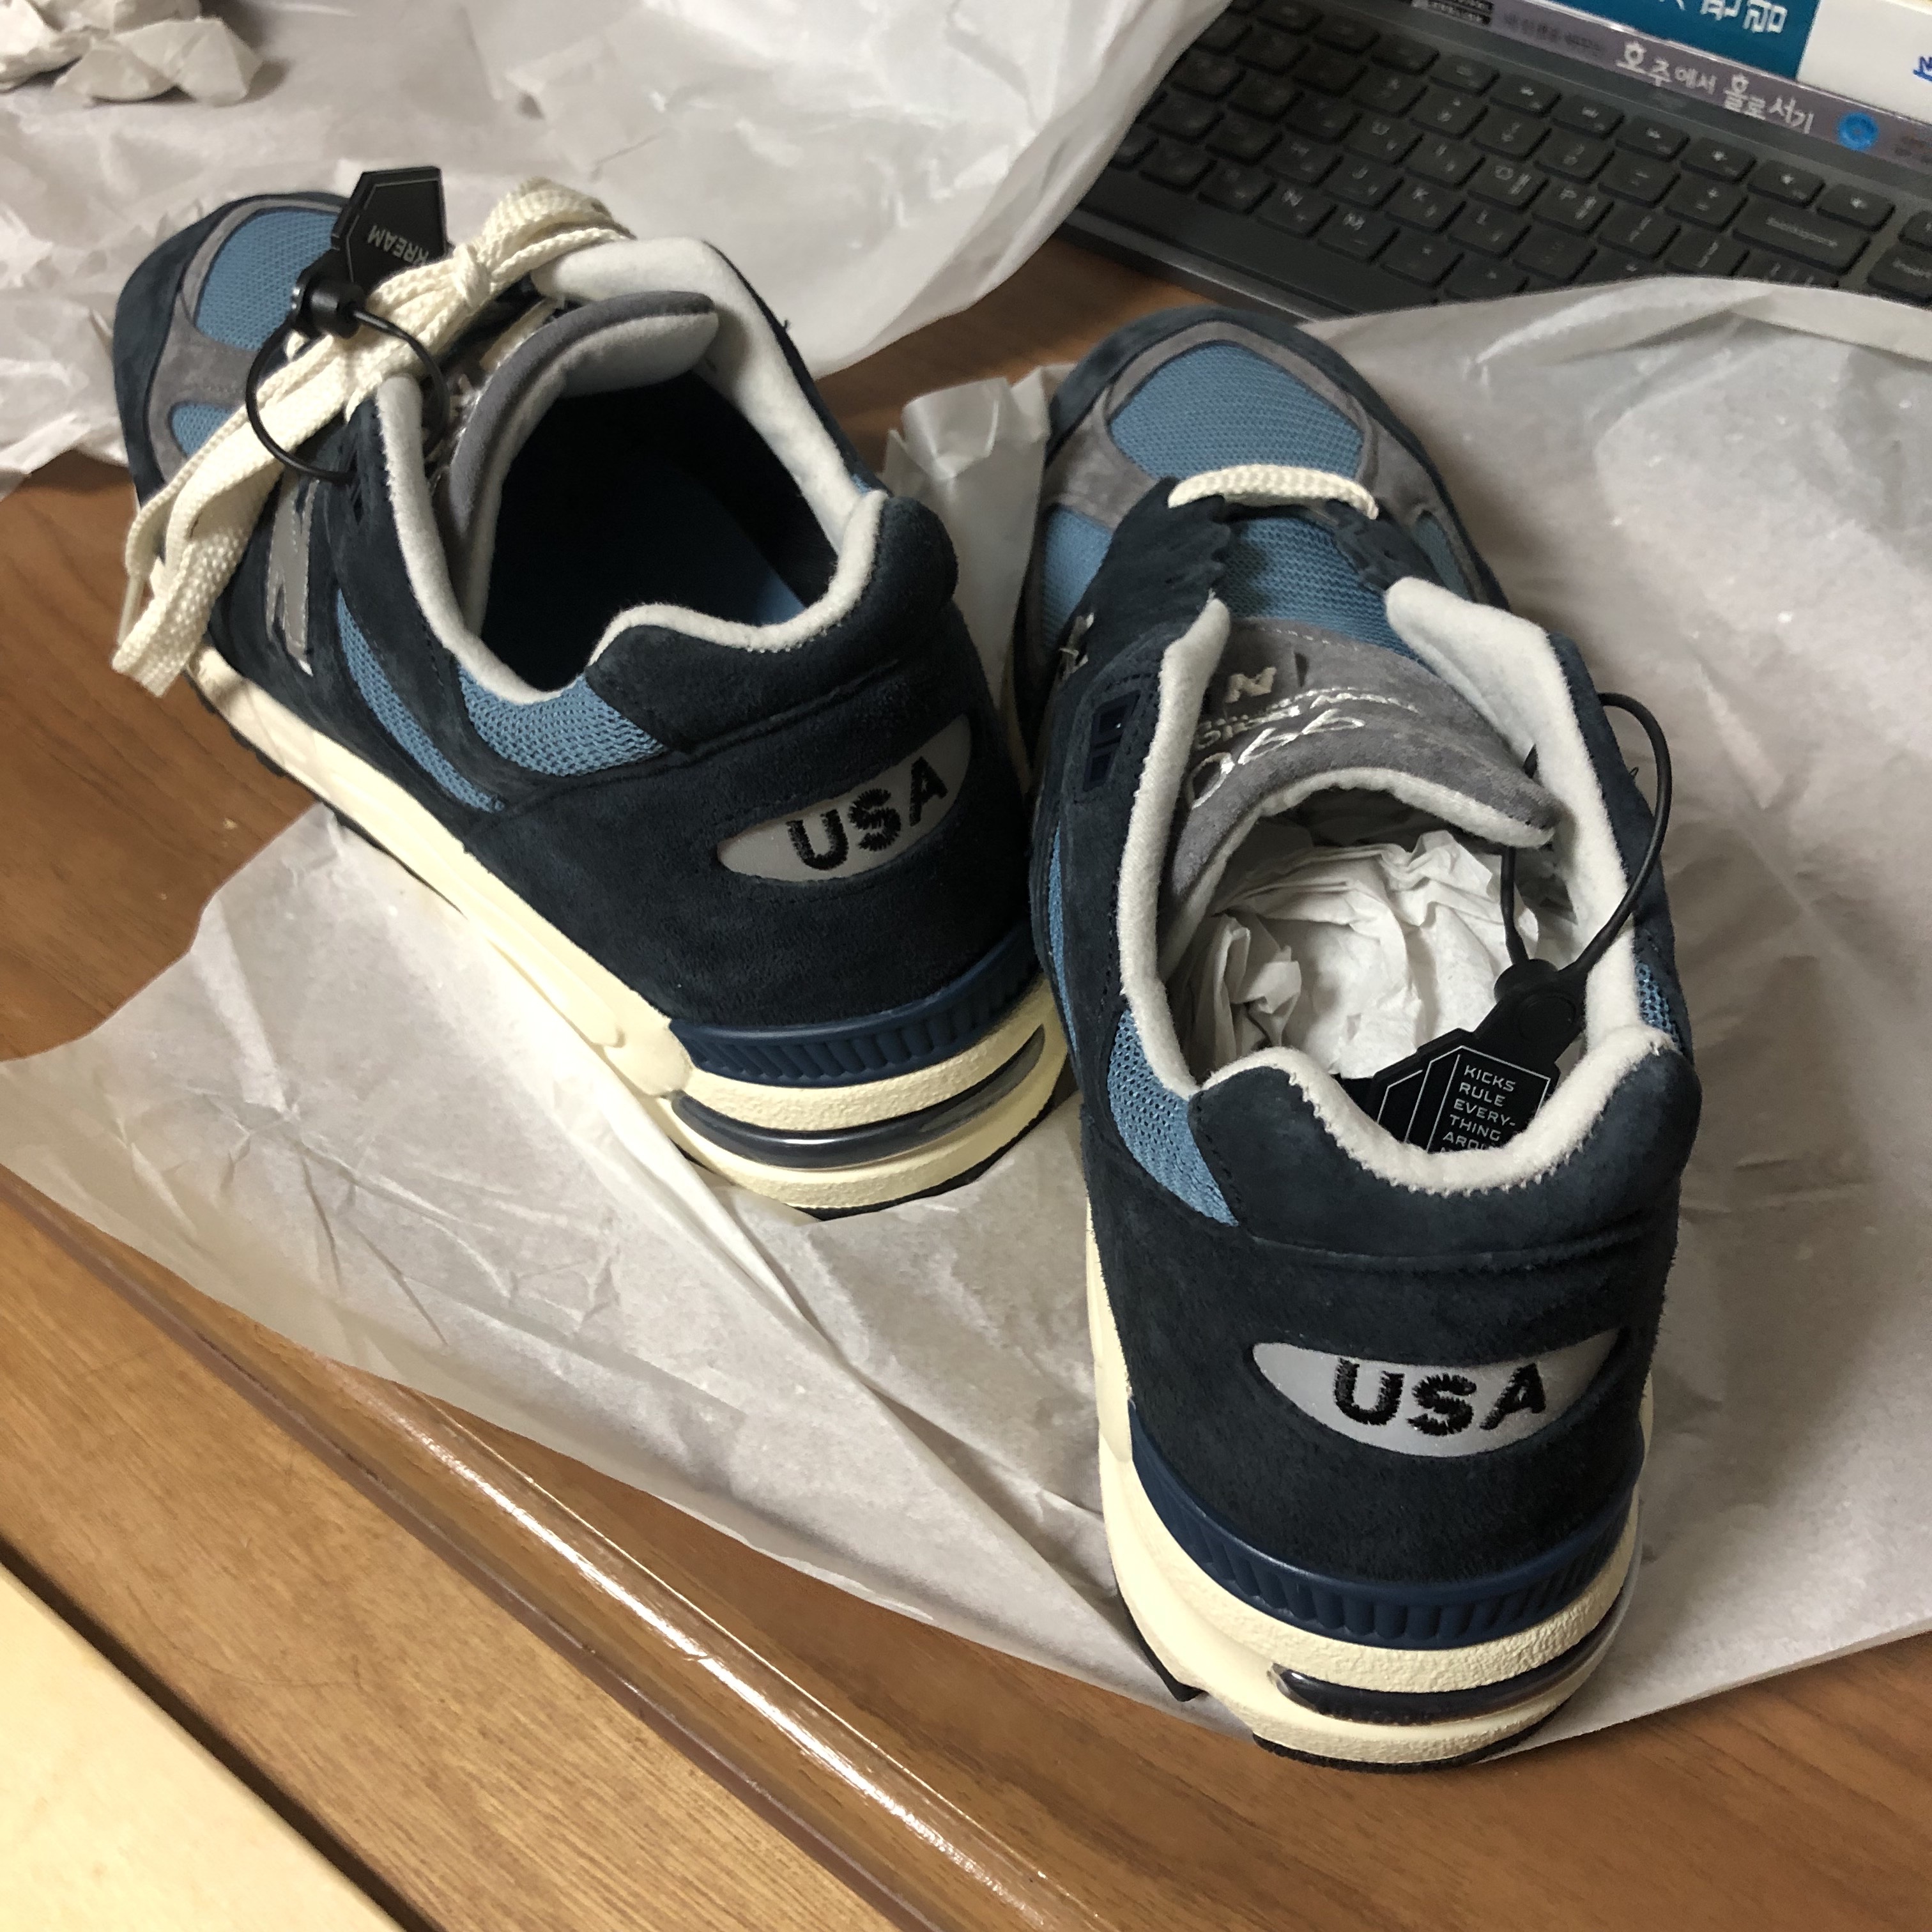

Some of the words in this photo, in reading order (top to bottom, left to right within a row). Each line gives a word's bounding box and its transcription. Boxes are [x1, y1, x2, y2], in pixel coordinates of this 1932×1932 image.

[1615, 40, 1717, 95] 호주에서
[1722, 73, 1815, 135] 홀로서기
[786, 755, 949, 871] USA
[1464, 1064, 1516, 1092] KICKS
[1459, 1082, 1506, 1107] RULE
[1453, 1098, 1516, 1126] EVERY-
[1449, 1114, 1501, 1142] THING
[1333, 1357, 1546, 1436] USA
